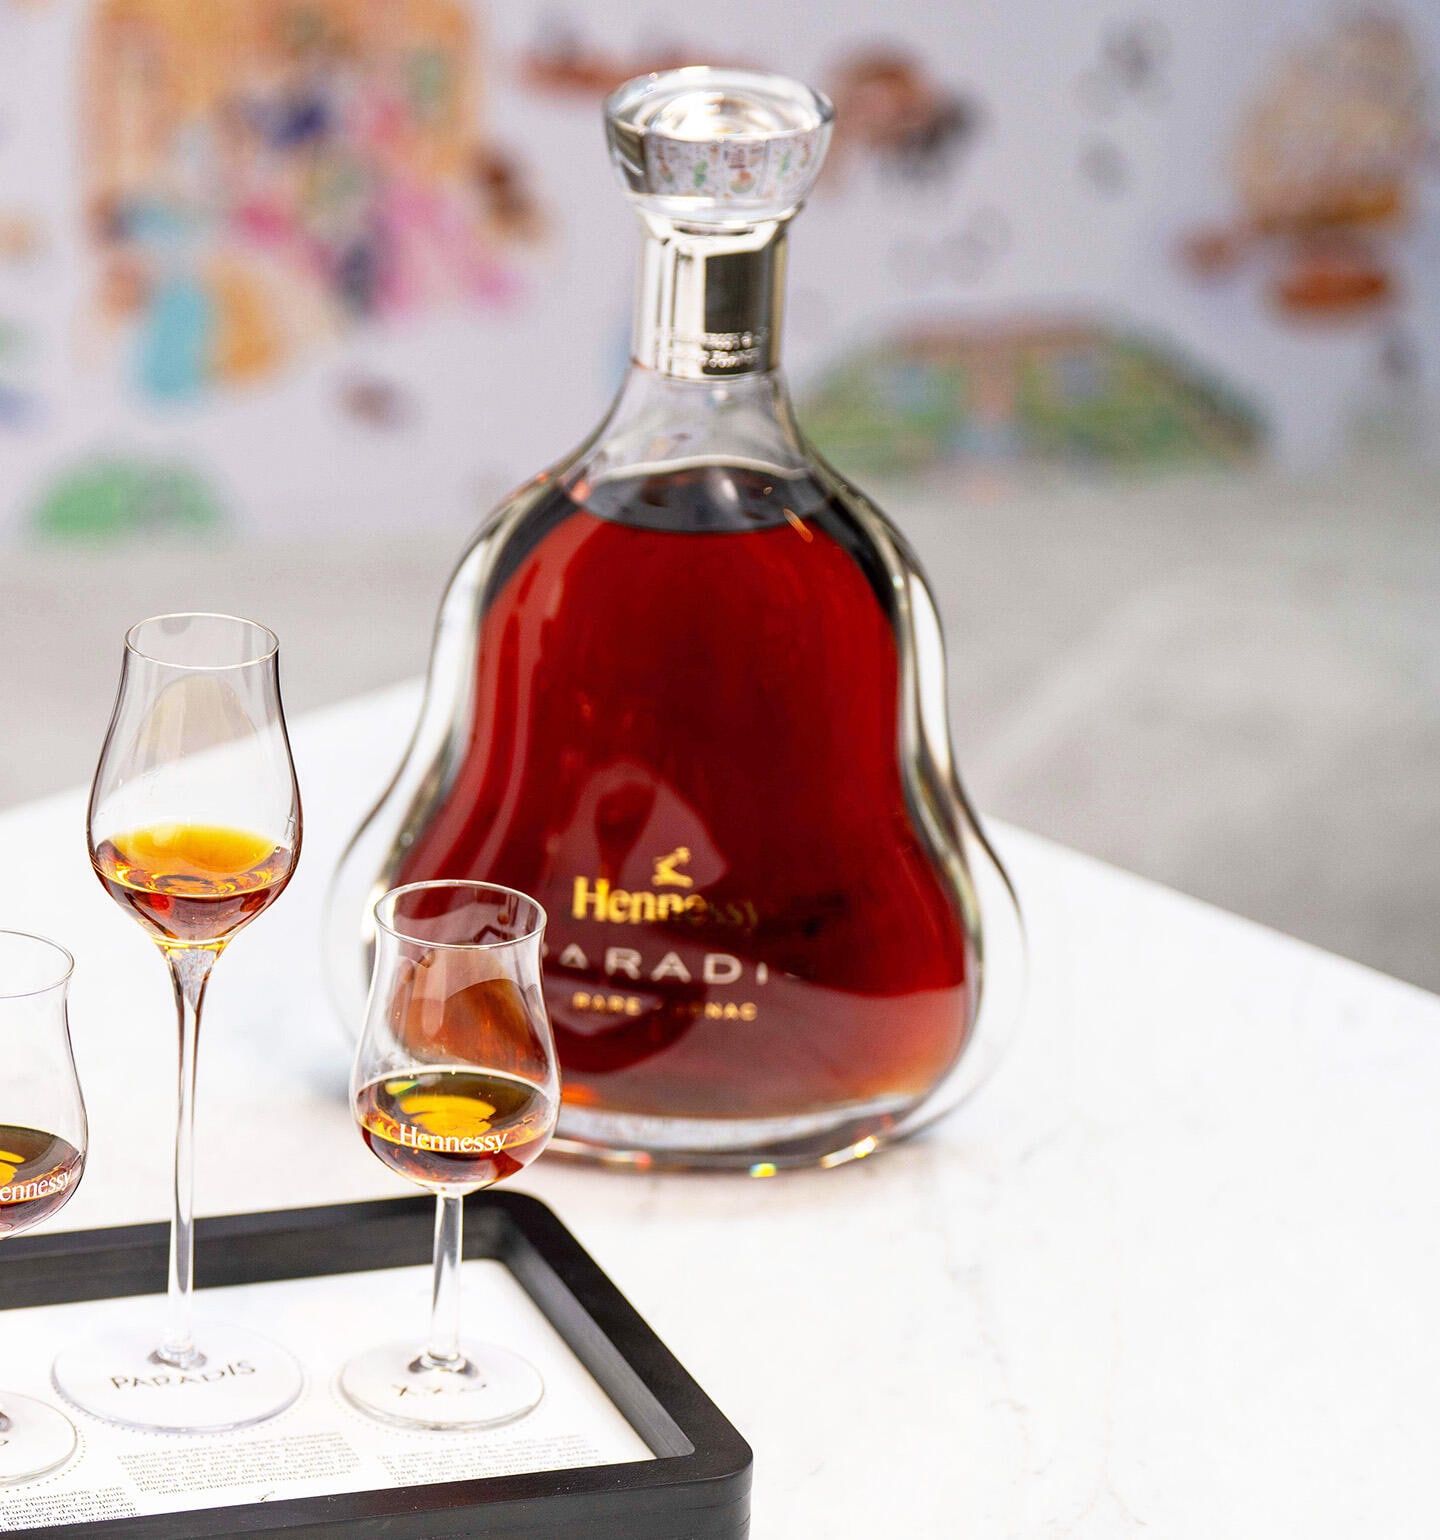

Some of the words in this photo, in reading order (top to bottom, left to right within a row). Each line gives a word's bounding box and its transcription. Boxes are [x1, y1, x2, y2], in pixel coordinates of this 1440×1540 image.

[399, 1122, 509, 1155] Hennessy
[24, 1497, 76, 1507] Hennessy
[34, 1503, 71, 1512] grande
[96, 1507, 135, 1515] couleur
